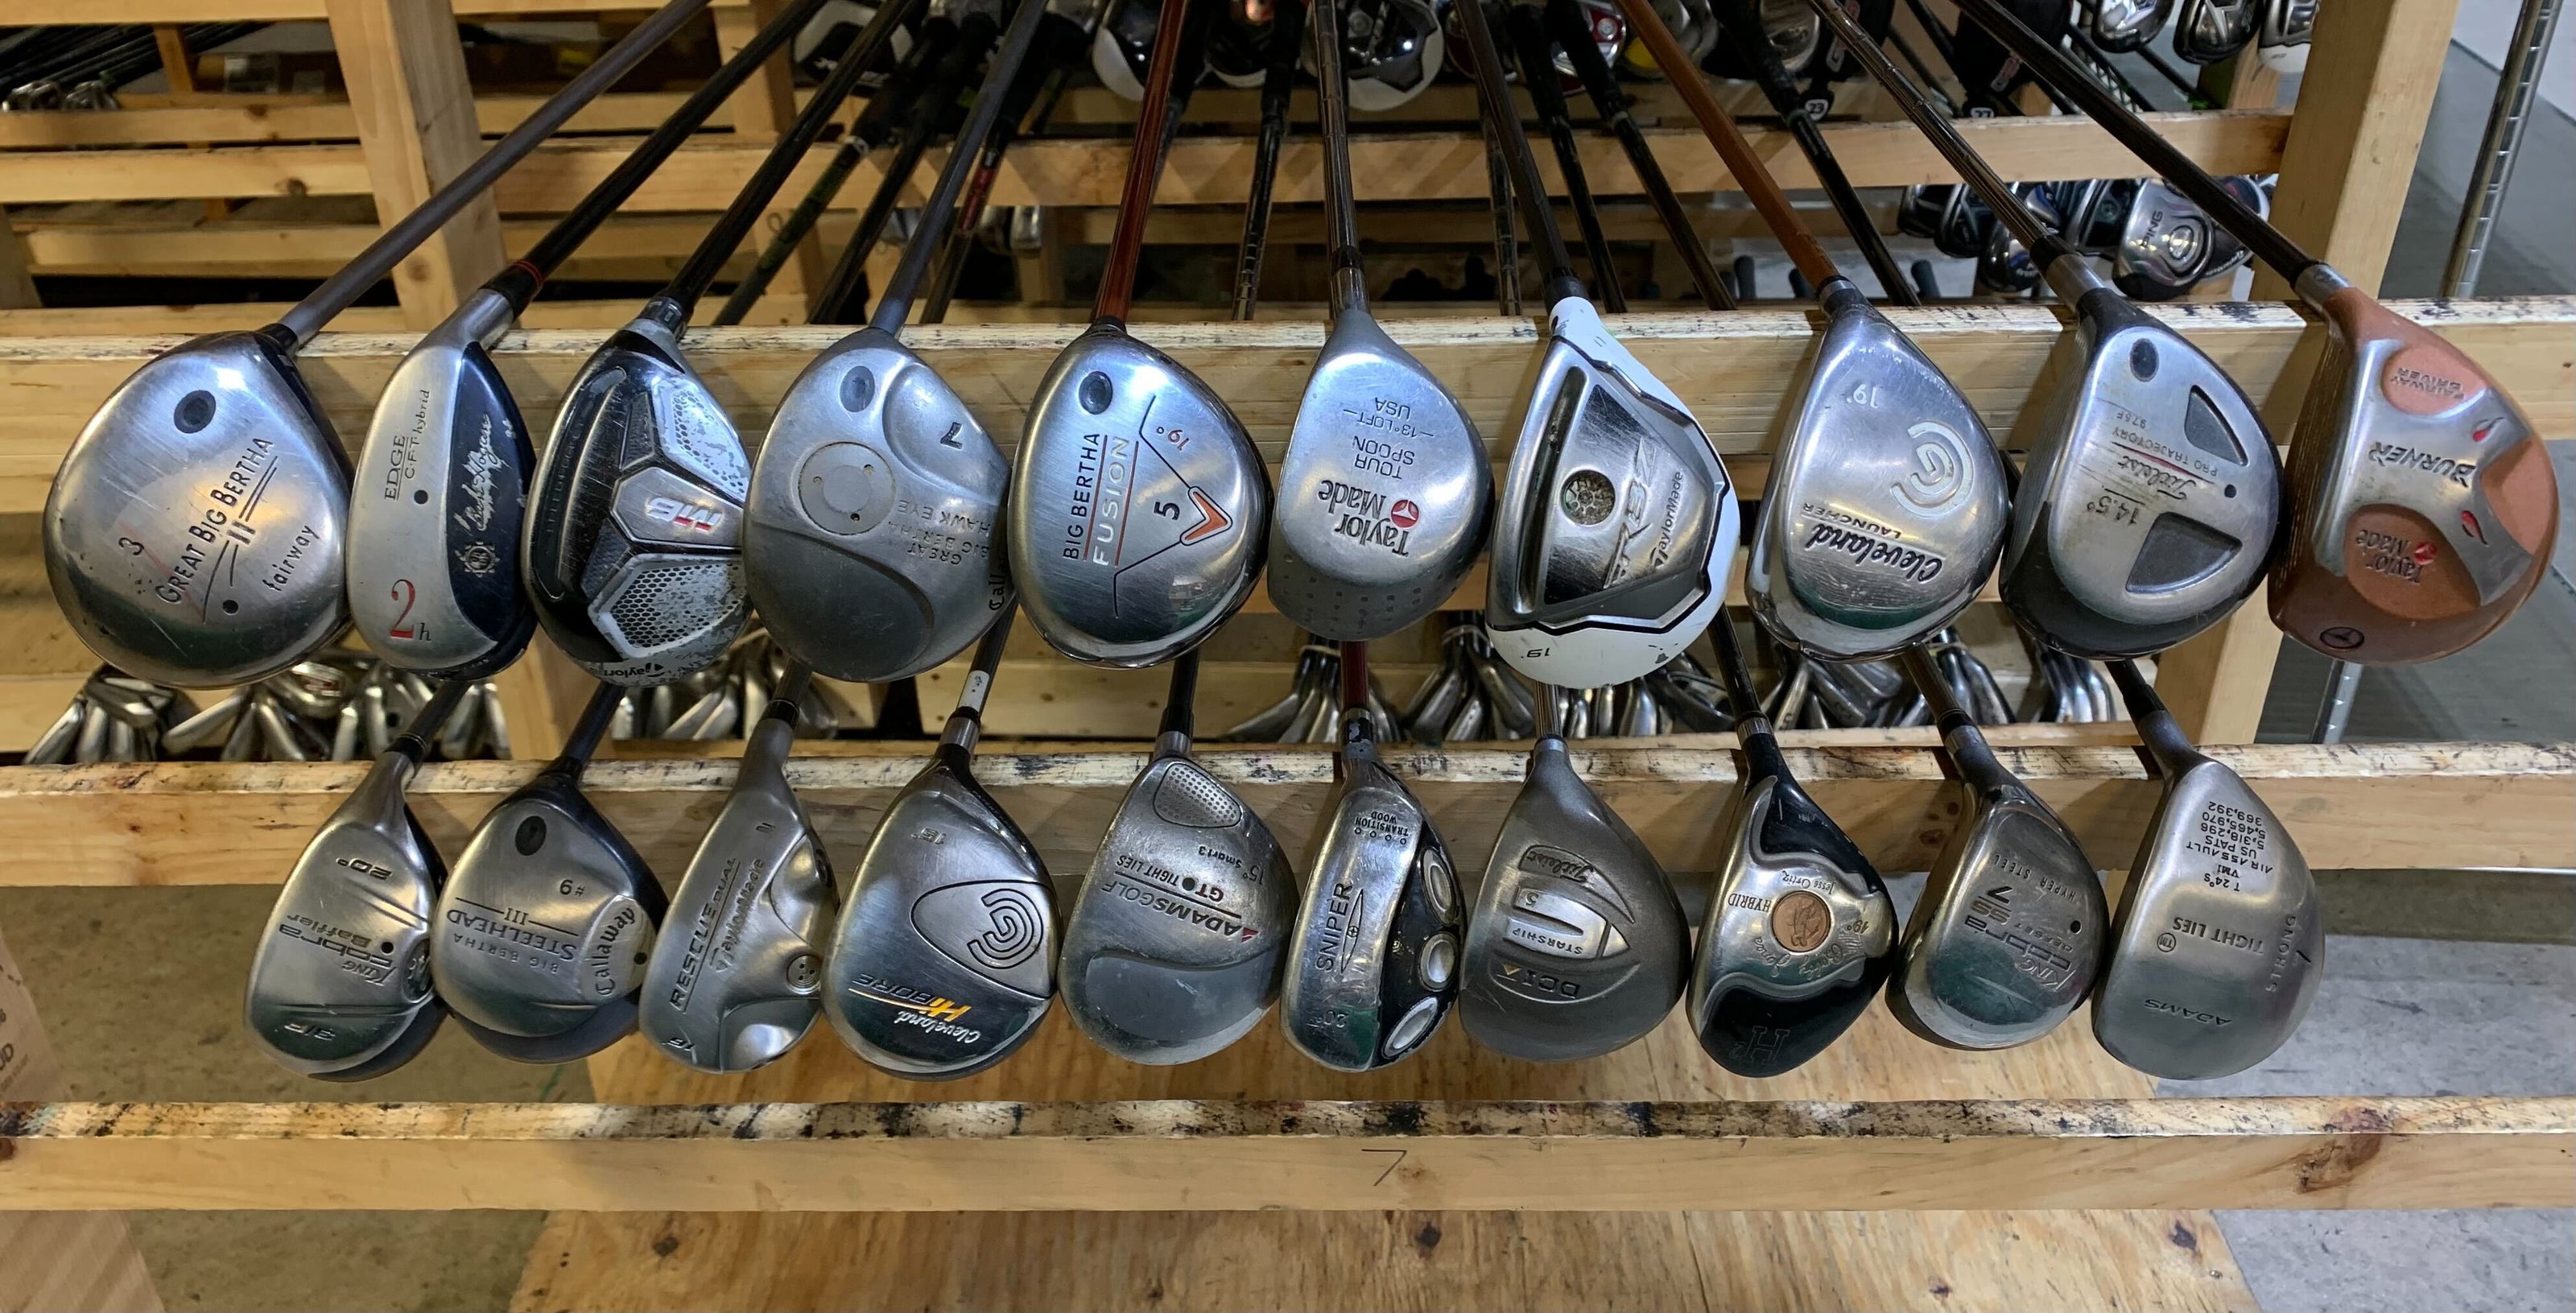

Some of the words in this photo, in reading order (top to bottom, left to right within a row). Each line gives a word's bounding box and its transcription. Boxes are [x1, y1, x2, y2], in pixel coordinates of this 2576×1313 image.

[2140, 209, 2164, 249] PING
[2390, 376, 2466, 401] FAIRWAY
[2396, 367, 2462, 391] DRIVER
[1374, 397, 1411, 420] USA
[940, 421, 964, 450] 7
[2112, 428, 2190, 465] TRAJECTORY
[1352, 436, 1415, 465] SPOON
[2368, 440, 2478, 489] BURNER
[384, 436, 406, 501] EDGE
[1071, 432, 1100, 517] BERTHA
[1355, 454, 1402, 480] TOUR
[2117, 455, 2196, 501] Titleist
[2194, 460, 2219, 477] PRO
[897, 500, 934, 521] EYE
[1092, 436, 1130, 566] FUSION
[1154, 501, 1180, 521] 5
[1318, 479, 1386, 518] Made
[155, 544, 205, 604] GREAT
[188, 510, 227, 543] BIG
[210, 438, 273, 506] BERTHA
[939, 510, 990, 538] HAWK
[1649, 470, 1684, 568] TaylorMade
[1802, 501, 1901, 539] LAUNCHER
[118, 537, 144, 555] 3
[887, 521, 956, 550] BERTHA
[961, 540, 989, 559] BIG
[1063, 524, 1084, 560] BIG
[1335, 513, 1410, 557] Taylor
[2355, 529, 2411, 559] Made
[262, 526, 319, 591] fairway
[907, 543, 963, 565] GREAT
[1806, 522, 1944, 584] Cleveland
[2364, 555, 2422, 586] Taylor
[391, 579, 415, 638] 2
[419, 623, 431, 641] h
[1355, 816, 1410, 837] TRANSITION
[1370, 811, 1397, 824] WOOD
[2201, 811, 2267, 840] 5,465,970
[2207, 800, 2263, 827] 369,392
[2199, 821, 2265, 850] 5,318,296
[2205, 834, 2236, 853] PATS
[1117, 855, 1144, 873] LIES
[1525, 850, 1594, 884] Titleist
[1992, 853, 2033, 881] STEEL
[2240, 846, 2257, 860] US
[1144, 865, 1179, 886] TIGHT
[1781, 870, 1811, 890] Ortiz
[1813, 879, 1836, 895] Jesse
[2039, 875, 2078, 902] HYPER
[1195, 884, 1224, 902] GT
[1525, 892, 1539, 908] 5
[1728, 892, 1772, 913] HYBRID
[1987, 886, 2013, 904] 7
[504, 908, 529, 926] III
[710, 858, 765, 973] TaylorMade
[1971, 898, 2012, 925] SS
[287, 913, 374, 948] Baffler
[446, 908, 578, 961] STEELHEAD
[1316, 882, 1352, 972] SNIPER
[1511, 927, 1583, 955] STARSHIP
[2016, 922, 2074, 953] OFFSET
[2172, 916, 2207, 938] LIES
[2209, 926, 2264, 955] TIGHT
[452, 932, 519, 964] BERTHA
[595, 906, 635, 997] Callaway
[670, 902, 718, 1012] RESCUE
[2264, 915, 2297, 993] STRONG
[342, 960, 397, 986] KING
[529, 956, 559, 974] BIG
[2014, 956, 2077, 993] KING
[1521, 969, 1581, 999] DCI
[2144, 997, 2233, 1027] ADAMS
[894, 1010, 982, 1044] Cleveland
[1361, 1148, 1407, 1187] 7
